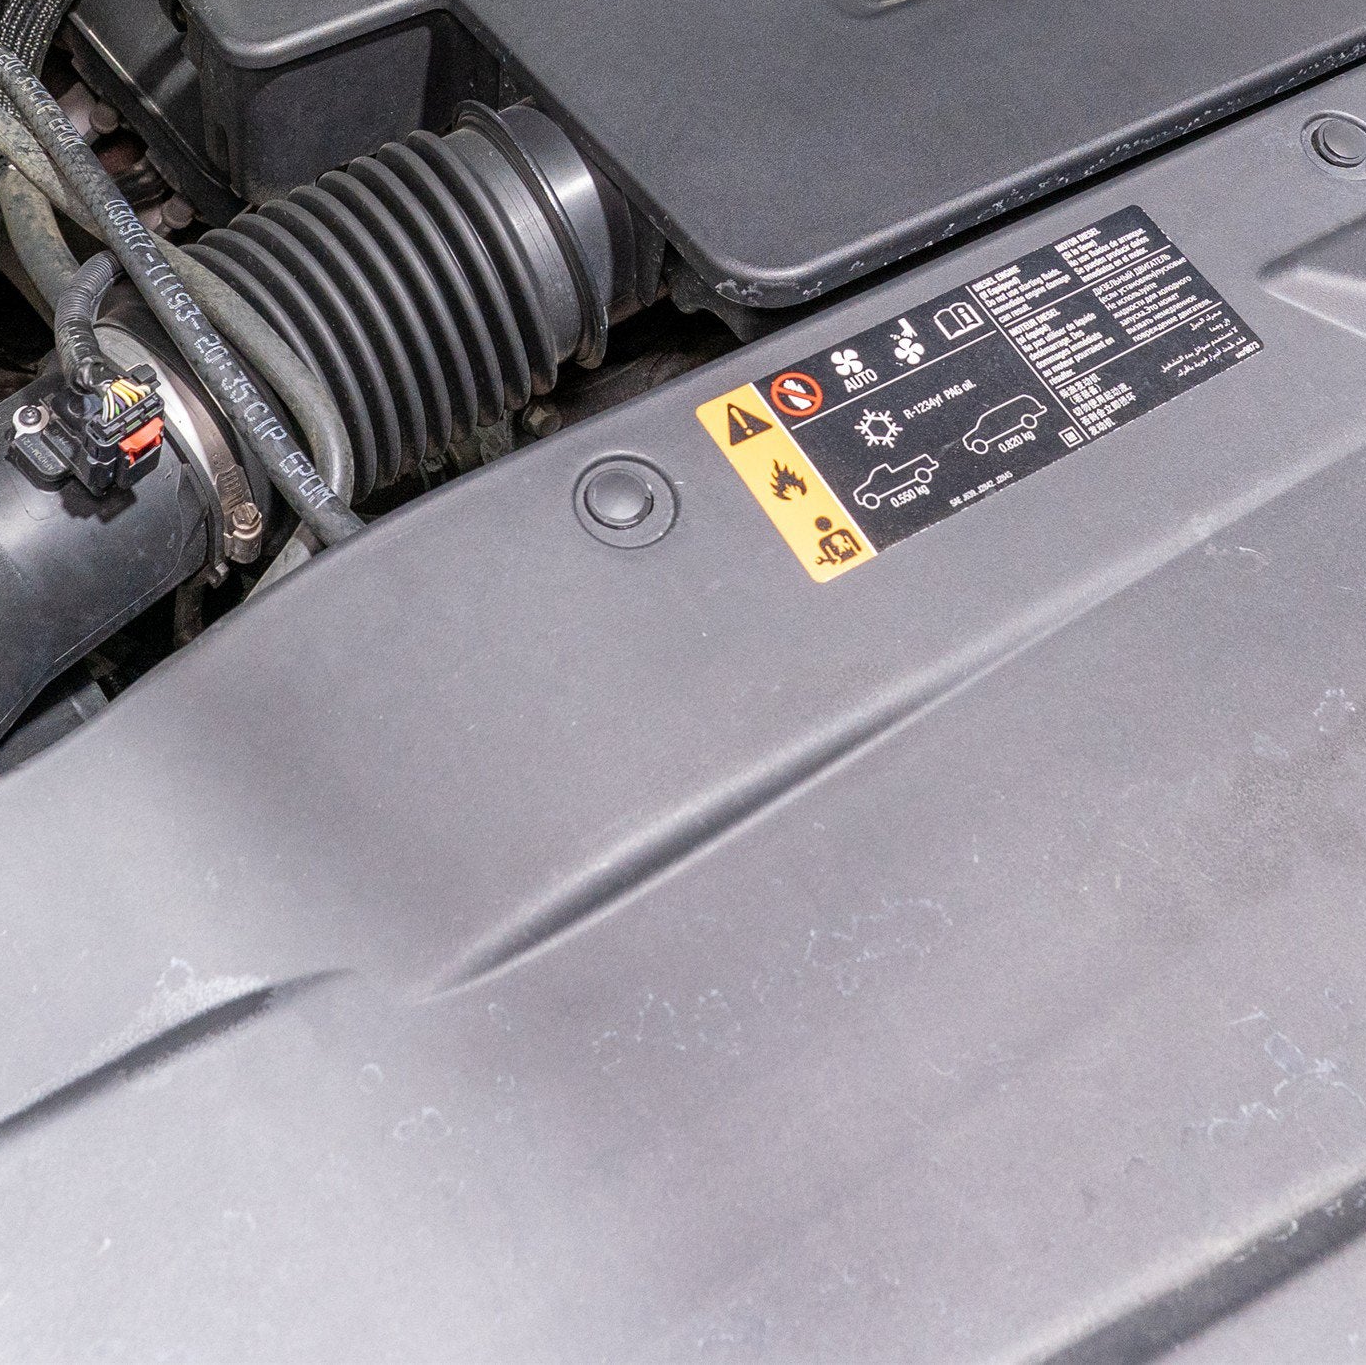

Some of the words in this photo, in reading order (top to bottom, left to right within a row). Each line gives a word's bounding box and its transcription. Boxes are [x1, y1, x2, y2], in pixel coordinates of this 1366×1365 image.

[1054, 236, 1079, 252] MOTOR
[1076, 227, 1101, 242] DIESEL
[1066, 259, 1079, 267] No
[1076, 253, 1090, 263] use
[1087, 244, 1110, 257] fluidos
[1108, 239, 1119, 248] de
[1073, 266, 1085, 275] Se
[1083, 256, 1107, 272] pueden
[1105, 244, 1130, 261] producir
[1129, 235, 1149, 248] daños
[1112, 258, 1123, 266] en
[1121, 254, 1129, 262] el
[1127, 246, 1148, 259] motor.
[971, 276, 997, 292] DIESEL
[994, 264, 1020, 281] ENGINE
[1092, 270, 1134, 296] ДИЗЕЛЬНЫЙ
[1133, 253, 1170, 276] ДВИГАТЕЛЬ
[978, 290, 989, 300] (If
[986, 276, 1020, 296] Equipped)
[984, 298, 996, 307] Do
[994, 292, 1008, 303] not
[1005, 287, 1019, 297] use
[1018, 276, 1044, 292] starting
[1040, 268, 1062, 280] fluids.
[990, 295, 1025, 315] Immediate
[1024, 285, 1046, 299] engine
[1045, 274, 1071, 289] damage
[1098, 290, 1118, 304] (если
[1104, 302, 1117, 311] Не
[1116, 282, 1157, 305] используйте
[1112, 299, 1145, 318] жидкости
[1144, 292, 1158, 303] для
[1156, 275, 1191, 295] холодного
[1157, 292, 1179, 306] может
[998, 313, 1012, 323] can
[1010, 303, 1032, 317] result.
[1008, 318, 1037, 336] MOTEUR
[1035, 307, 1060, 323] DIESEL
[1125, 318, 1153, 334] вызвать
[1152, 294, 1197, 320] немедленное
[1132, 315, 1178, 341] повреждение
[1177, 298, 1212, 319] двигателя.
[1015, 334, 1027, 345] (si
[1021, 343, 1033, 352] Ne
[1031, 337, 1046, 349] pas
[1044, 326, 1066, 341] utiliser
[1072, 312, 1096, 326] liquide
[1069, 329, 1085, 340] Des
[1035, 348, 1071, 369] dommages
[1067, 331, 1102, 351] immédiats
[1041, 368, 1053, 377] au
[1051, 357, 1074, 372] moteur
[1073, 340, 1106, 362] pourraient
[1104, 336, 1115, 345] en
[1235, 341, 1259, 358] 9873
[843, 368, 877, 392] AUTO
[1048, 368, 1075, 385] résulter.
[1058, 373, 1100, 398] 柴油发动机
[902, 393, 943, 419] R-1234yf
[942, 384, 963, 399] PAG
[961, 378, 976, 391] oil.
[1088, 417, 1115, 435] 发动机
[997, 434, 1023, 452] 0.820
[1020, 430, 1036, 441] kg
[890, 488, 916, 507] 0.550
[913, 482, 930, 495] kg
[949, 496, 963, 507] SAE
